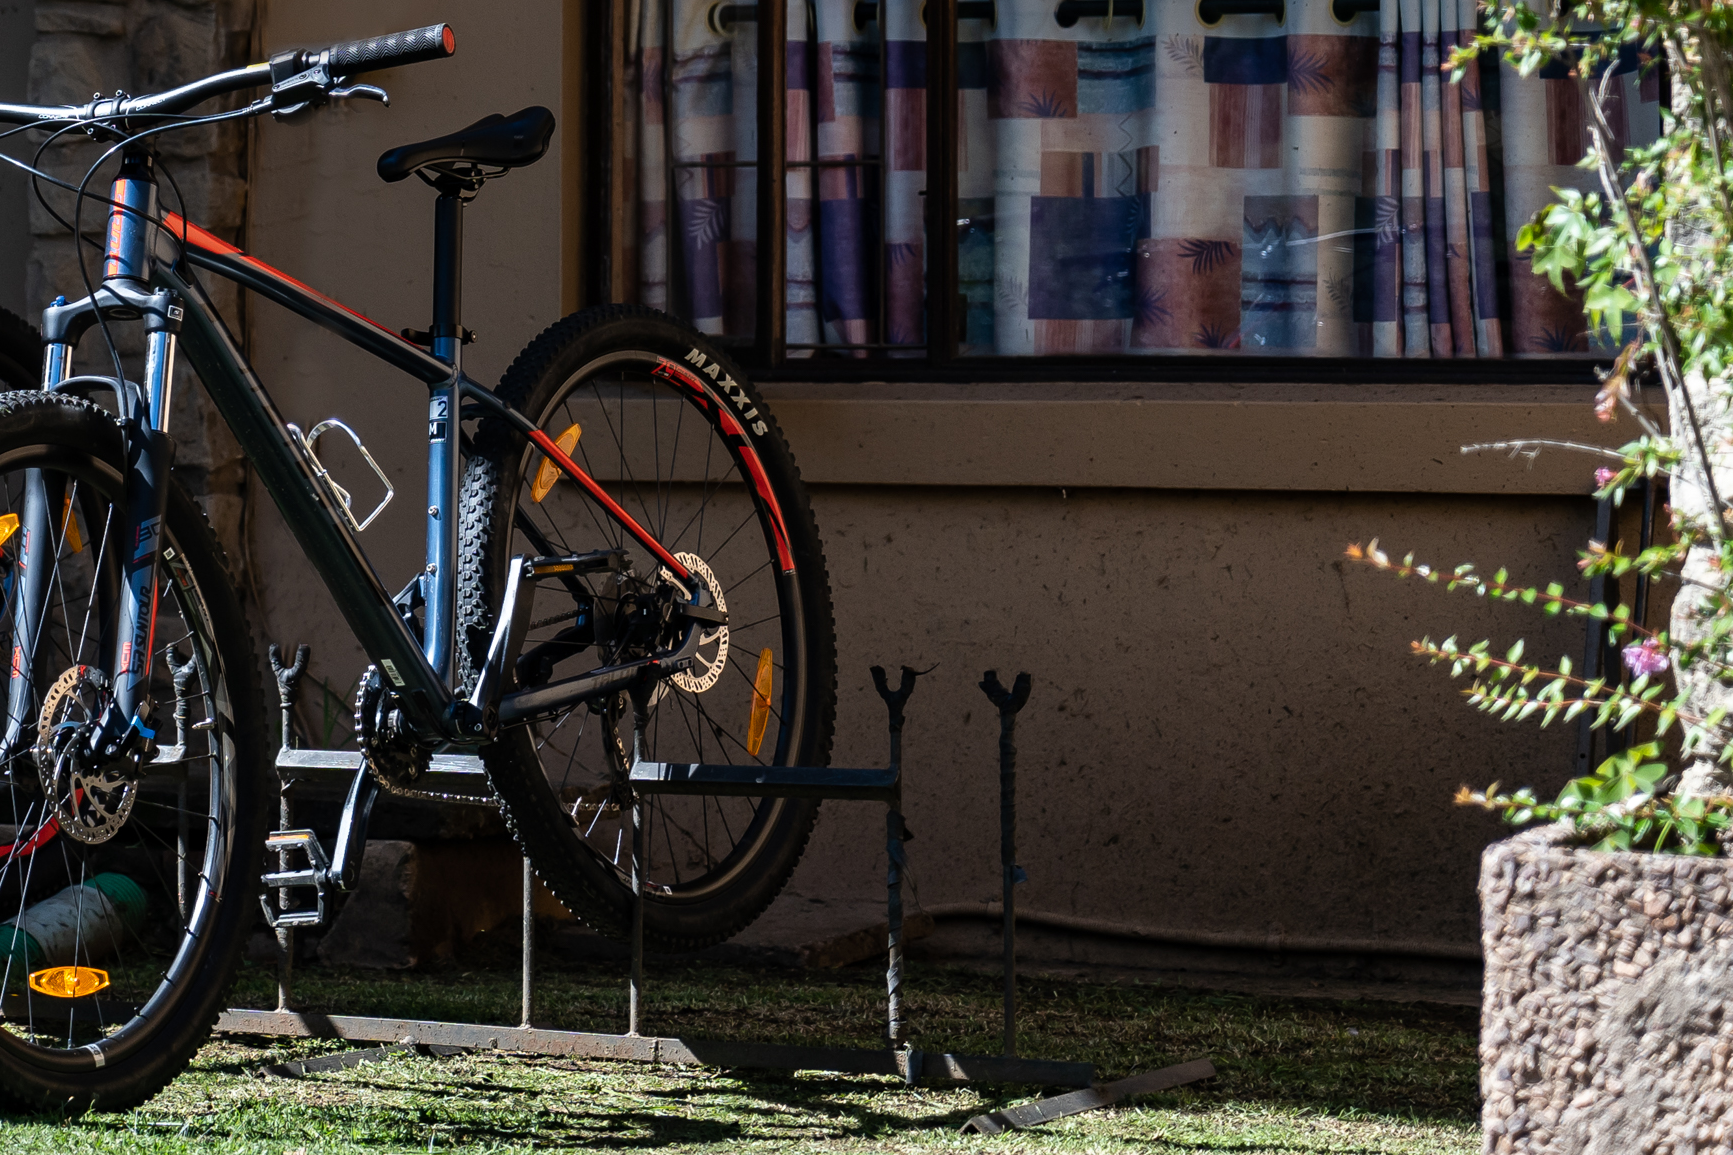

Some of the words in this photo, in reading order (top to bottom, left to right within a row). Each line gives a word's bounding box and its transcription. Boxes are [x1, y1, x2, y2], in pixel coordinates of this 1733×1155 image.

[438, 400, 447, 417] 2
[684, 347, 769, 437] MAXXIS
[135, 585, 152, 650] SUNTOUR
